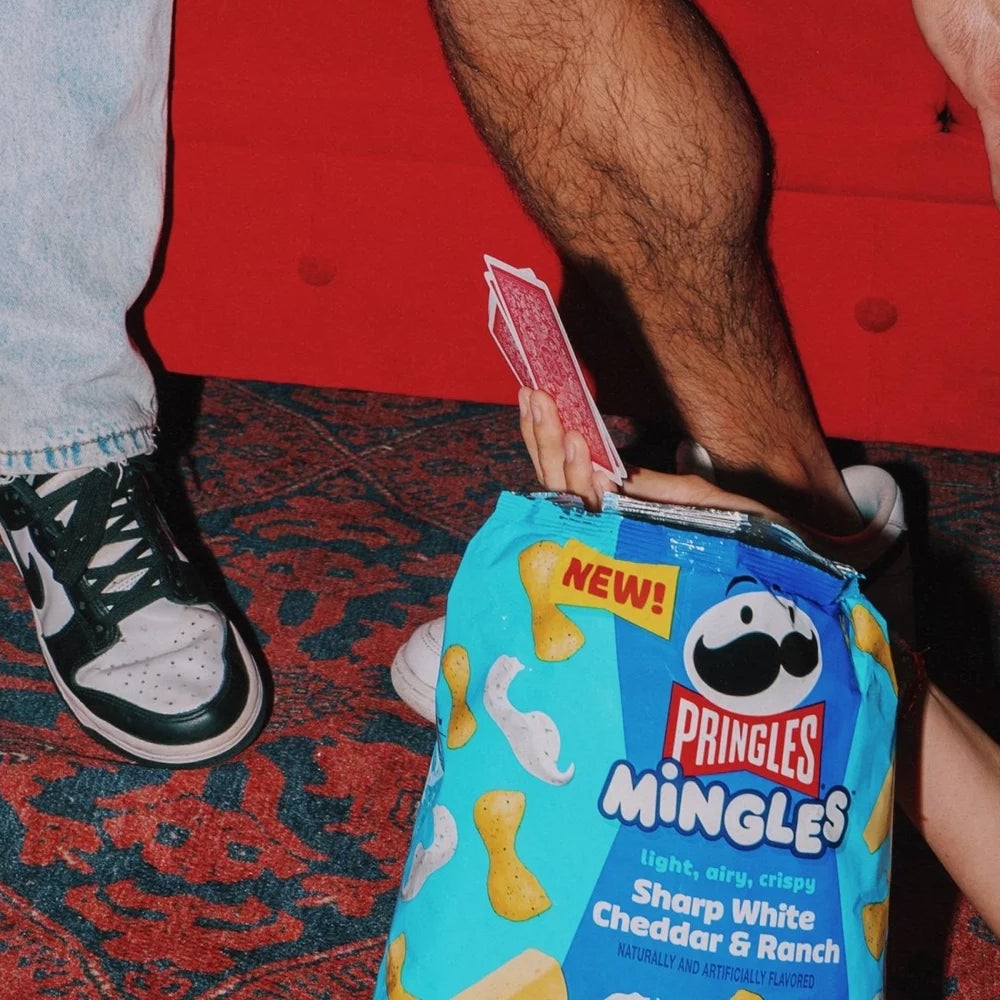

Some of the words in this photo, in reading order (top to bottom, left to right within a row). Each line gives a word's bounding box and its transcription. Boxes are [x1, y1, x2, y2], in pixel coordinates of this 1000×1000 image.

[562, 557, 666, 615] NEW!
[672, 697, 818, 785] PRINGLES
[640, 848, 699, 881] light,
[705, 865, 754, 889] airy,
[759, 872, 816, 895] crispy
[592, 900, 724, 953] Cheddar
[728, 930, 751, 958] &
[757, 933, 840, 964] Ranch
[631, 878, 725, 925] Sharp
[732, 898, 816, 931] White
[617, 942, 677, 970] NATURALLY
[677, 958, 700, 976] AND
[701, 962, 767, 985] ARTIFICIALLY
[768, 971, 815, 990] FLAVORED
